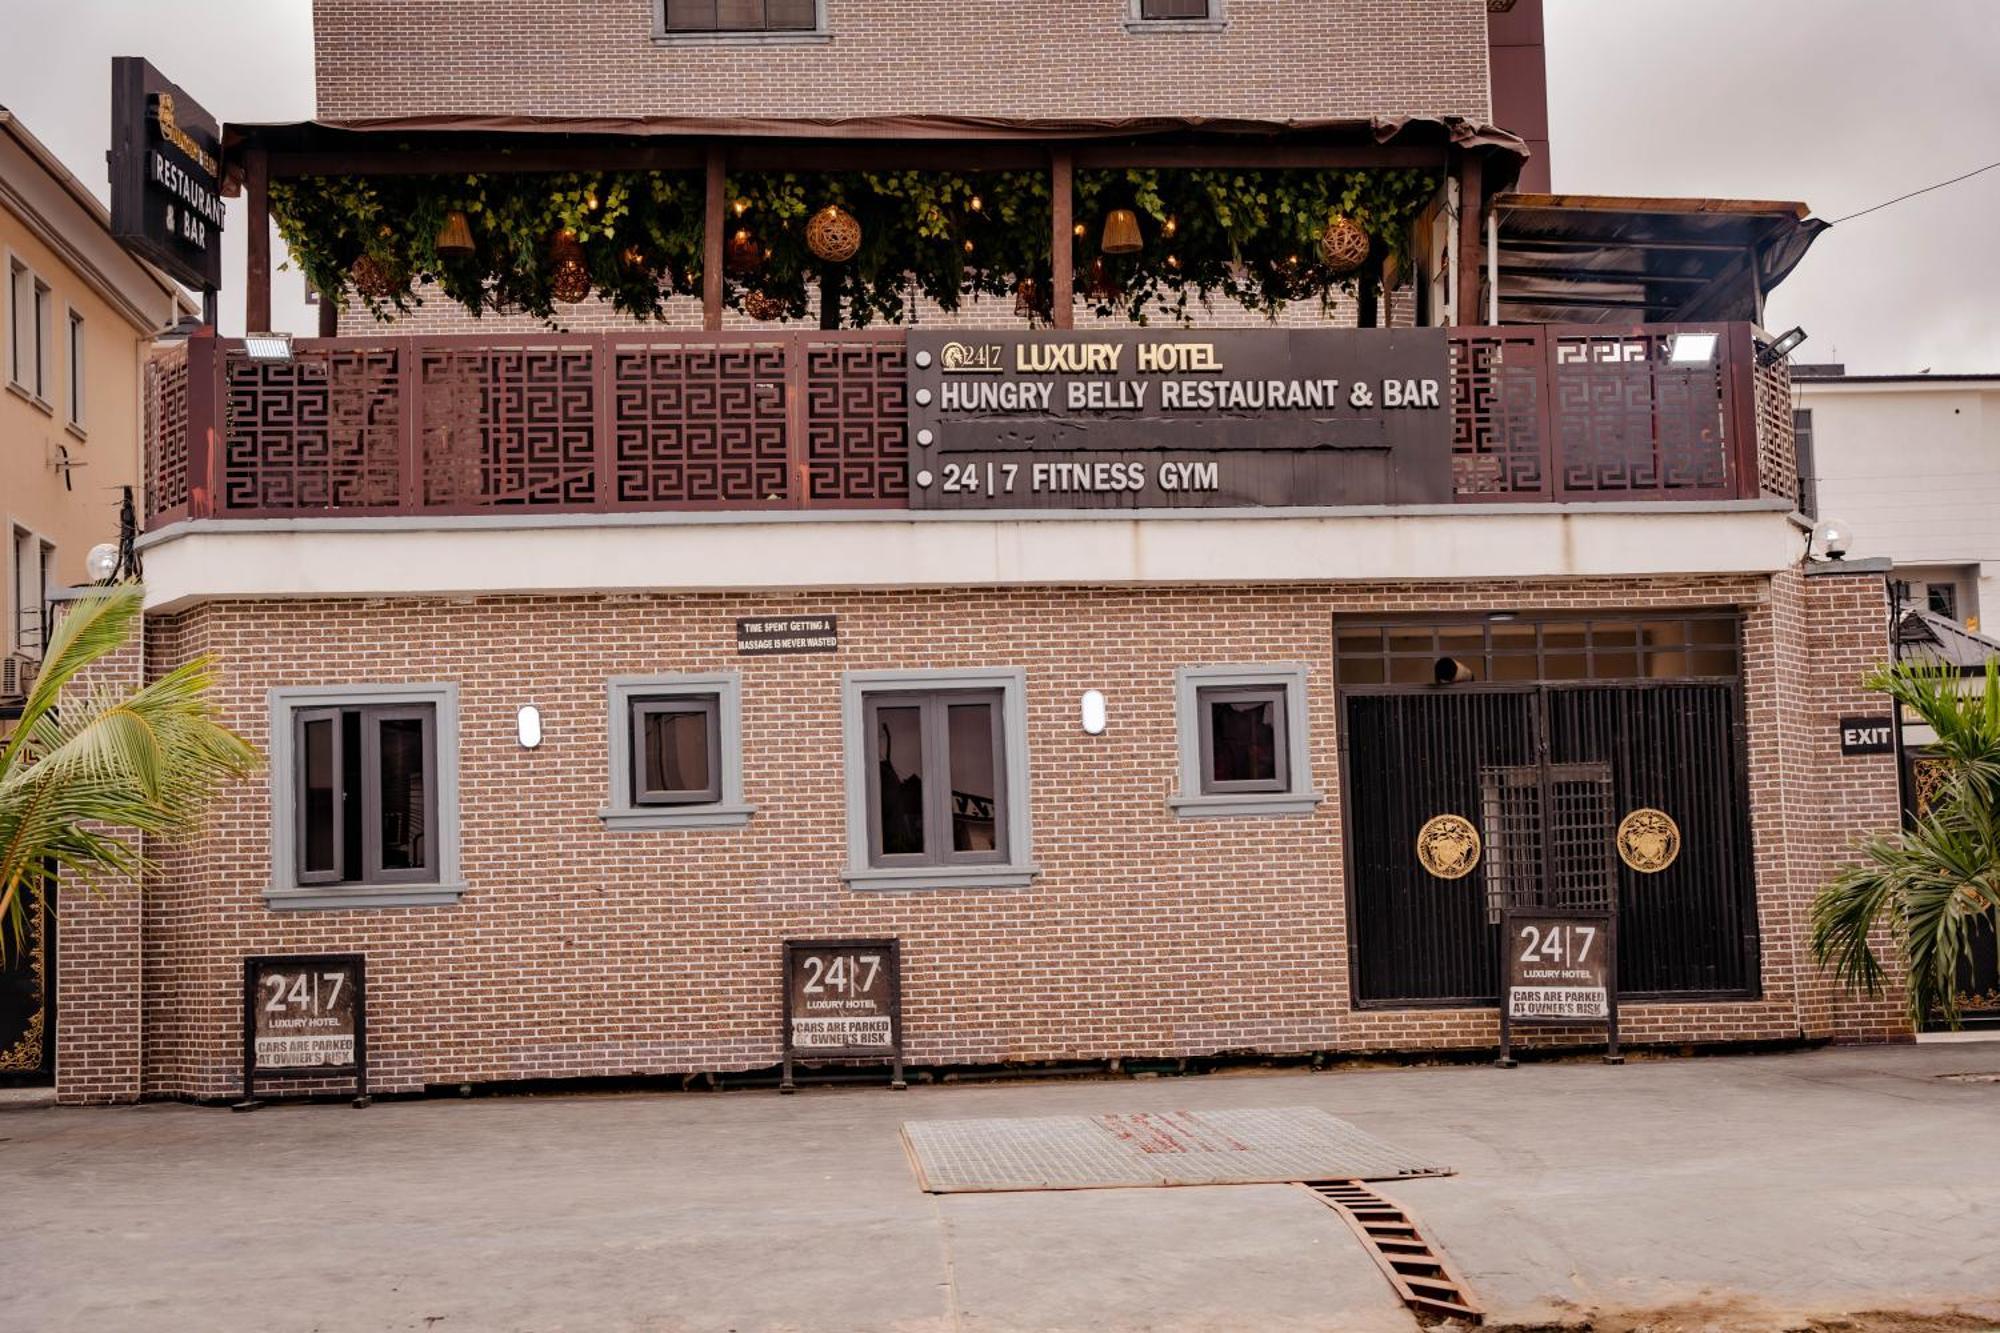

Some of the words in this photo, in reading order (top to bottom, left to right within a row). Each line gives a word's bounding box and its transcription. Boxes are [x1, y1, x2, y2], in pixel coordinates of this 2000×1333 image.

[156, 153, 226, 233] RESTAURANT
[166, 204, 175, 232] &
[184, 210, 206, 249] BAR
[1016, 343, 1123, 371] LUXURY
[1138, 343, 1224, 371] HOTEL
[941, 381, 1054, 410] HUNGRY
[1067, 381, 1149, 409] BELLY
[1161, 380, 1339, 409] RESTAURANT
[1350, 382, 1373, 407] &
[1384, 379, 1439, 408] BAR
[1032, 462, 1145, 491] FITNESS
[1159, 462, 1218, 490] GYM
[744, 623, 763, 633] TIME
[765, 622, 788, 632] SPENT
[790, 621, 823, 631] GETTING
[824, 621, 830, 630] A
[738, 640, 773, 650] MASSAGE
[774, 639, 781, 648] IS
[782, 638, 806, 648] NEVER
[807, 637, 837, 647] WASTED
[1844, 727, 1891, 746] EXIT
[1520, 925, 1595, 968] 24|7
[803, 955, 881, 998] 24|7
[1523, 970, 1560, 978] LUXURY
[1562, 970, 1592, 978] HOTEL
[265, 972, 345, 1015] 24|7
[1514, 991, 1541, 1002] CARS
[1543, 991, 1562, 1002] ARE
[1565, 991, 1604, 1002] PARKED
[807, 1001, 844, 1009] LUXURY
[846, 1000, 877, 1009] HOTEL
[1513, 1003, 1526, 1013] AT
[1528, 1003, 1574, 1013] OWNER'S
[1577, 1003, 1601, 1014] RISK
[269, 1018, 308, 1029] LUXURY
[309, 1017, 341, 1027] HOTEL
[796, 1023, 824, 1033] CARS
[827, 1022, 847, 1032] ARE
[849, 1021, 889, 1032] PARKED
[860, 1033, 885, 1043] RISK
[258, 1042, 287, 1052] CARS
[289, 1041, 310, 1051] ARE
[312, 1040, 353, 1051] PARKED
[259, 1054, 271, 1064] AT
[274, 1052, 321, 1064] OWNER'S
